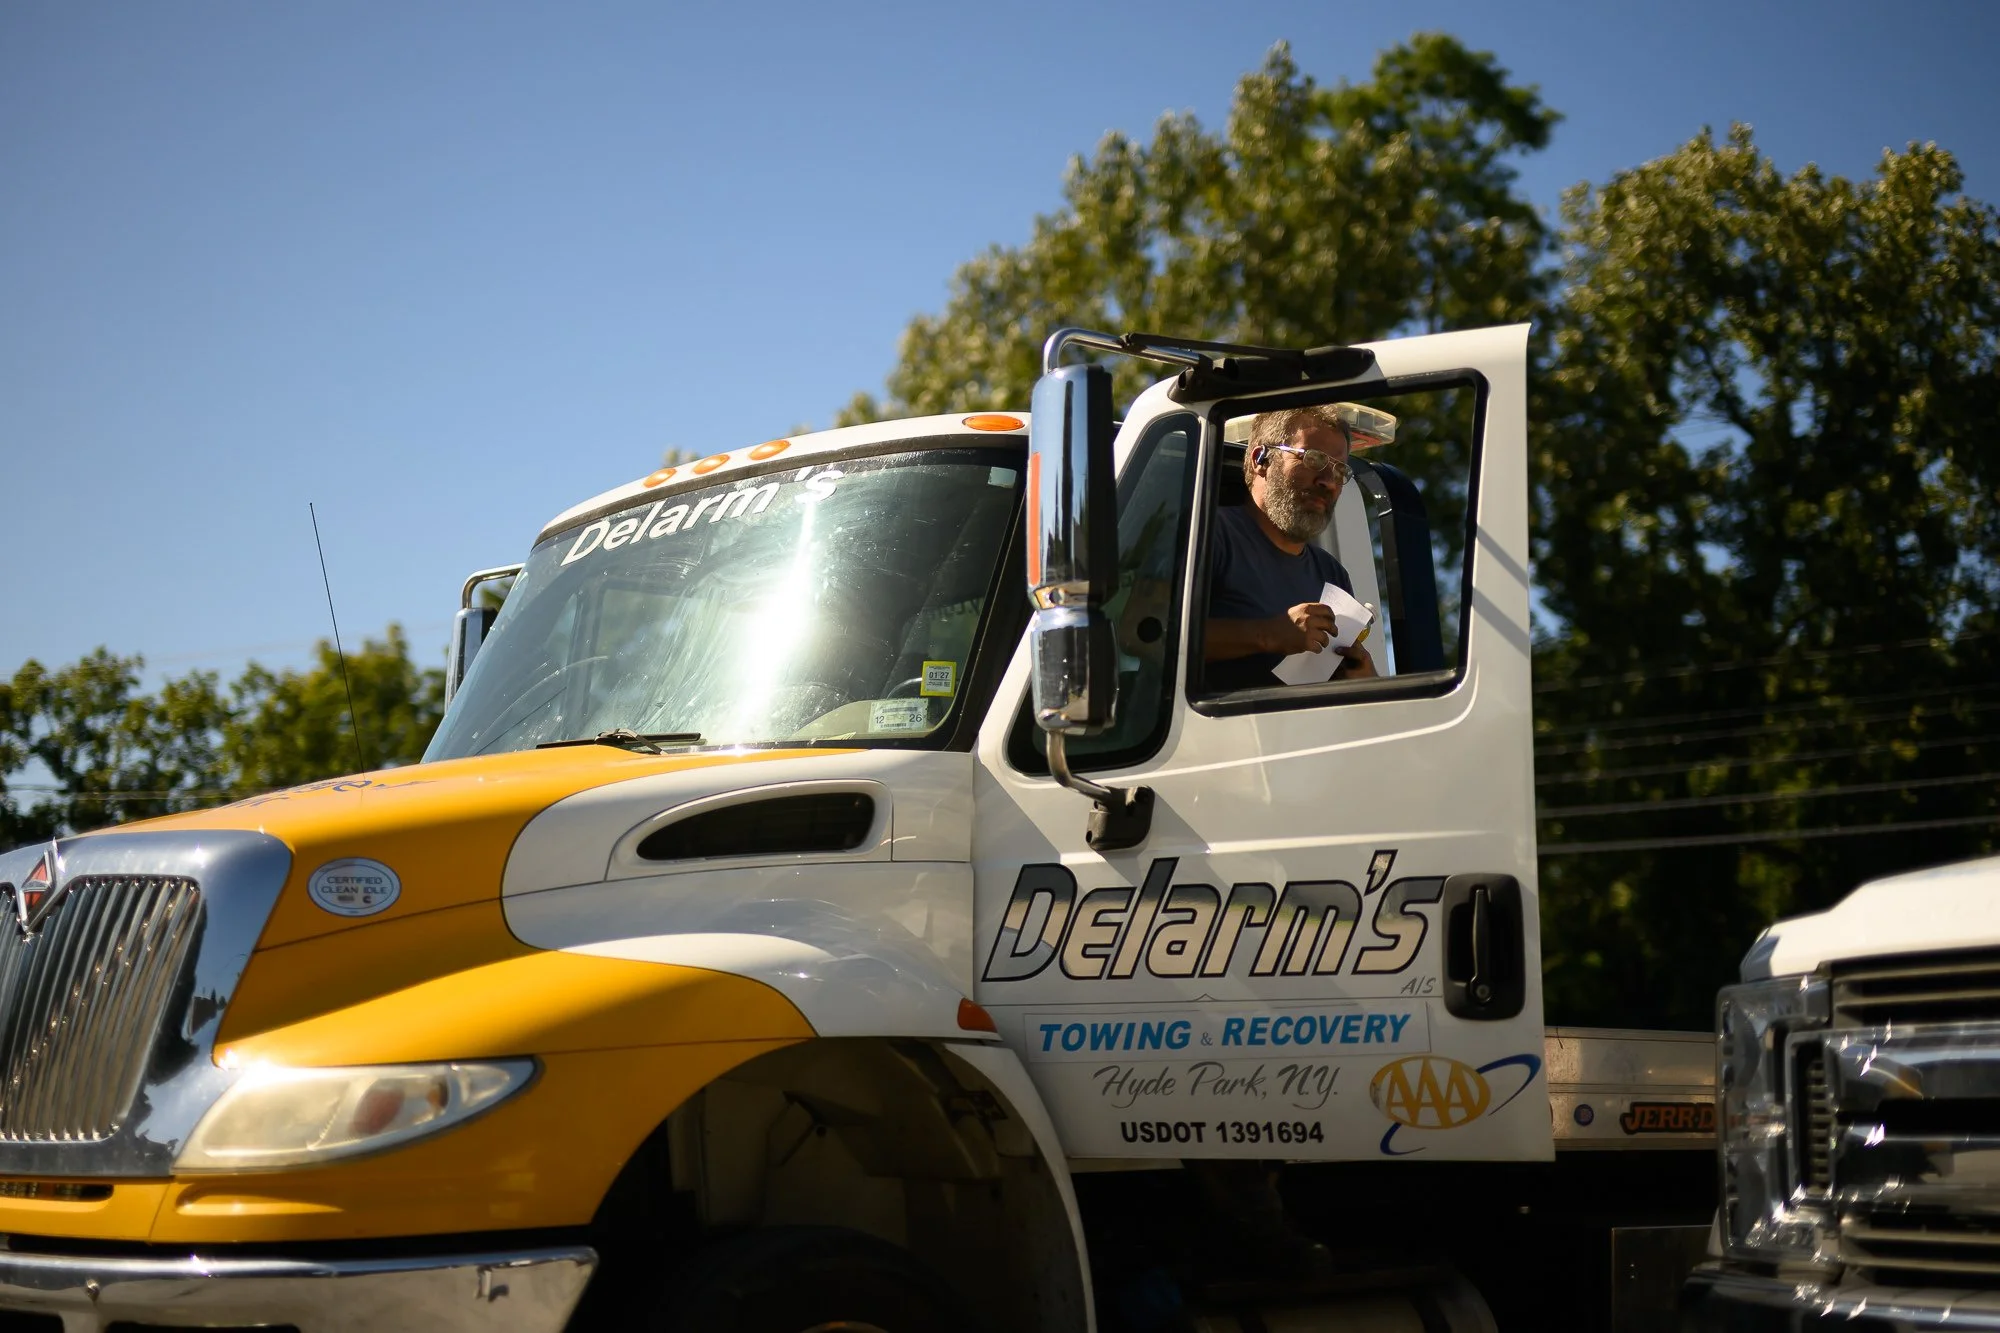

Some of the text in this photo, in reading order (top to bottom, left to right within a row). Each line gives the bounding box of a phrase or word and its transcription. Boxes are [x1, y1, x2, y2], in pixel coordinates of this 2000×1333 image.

[875, 713, 923, 724] 12 26
[321, 885, 388, 894] CLEAN IDLE
[326, 876, 383, 885] CERTIFIED
[981, 849, 1451, 982] Delarm's
[1400, 976, 1436, 995] A/S
[1039, 1013, 1411, 1052] TOWING & RECOVERY
[1093, 1061, 1341, 1110] Hyde Park, N.Y.
[1384, 1057, 1480, 1130] AAA
[1120, 1121, 1325, 1144] USDOT 1391694
